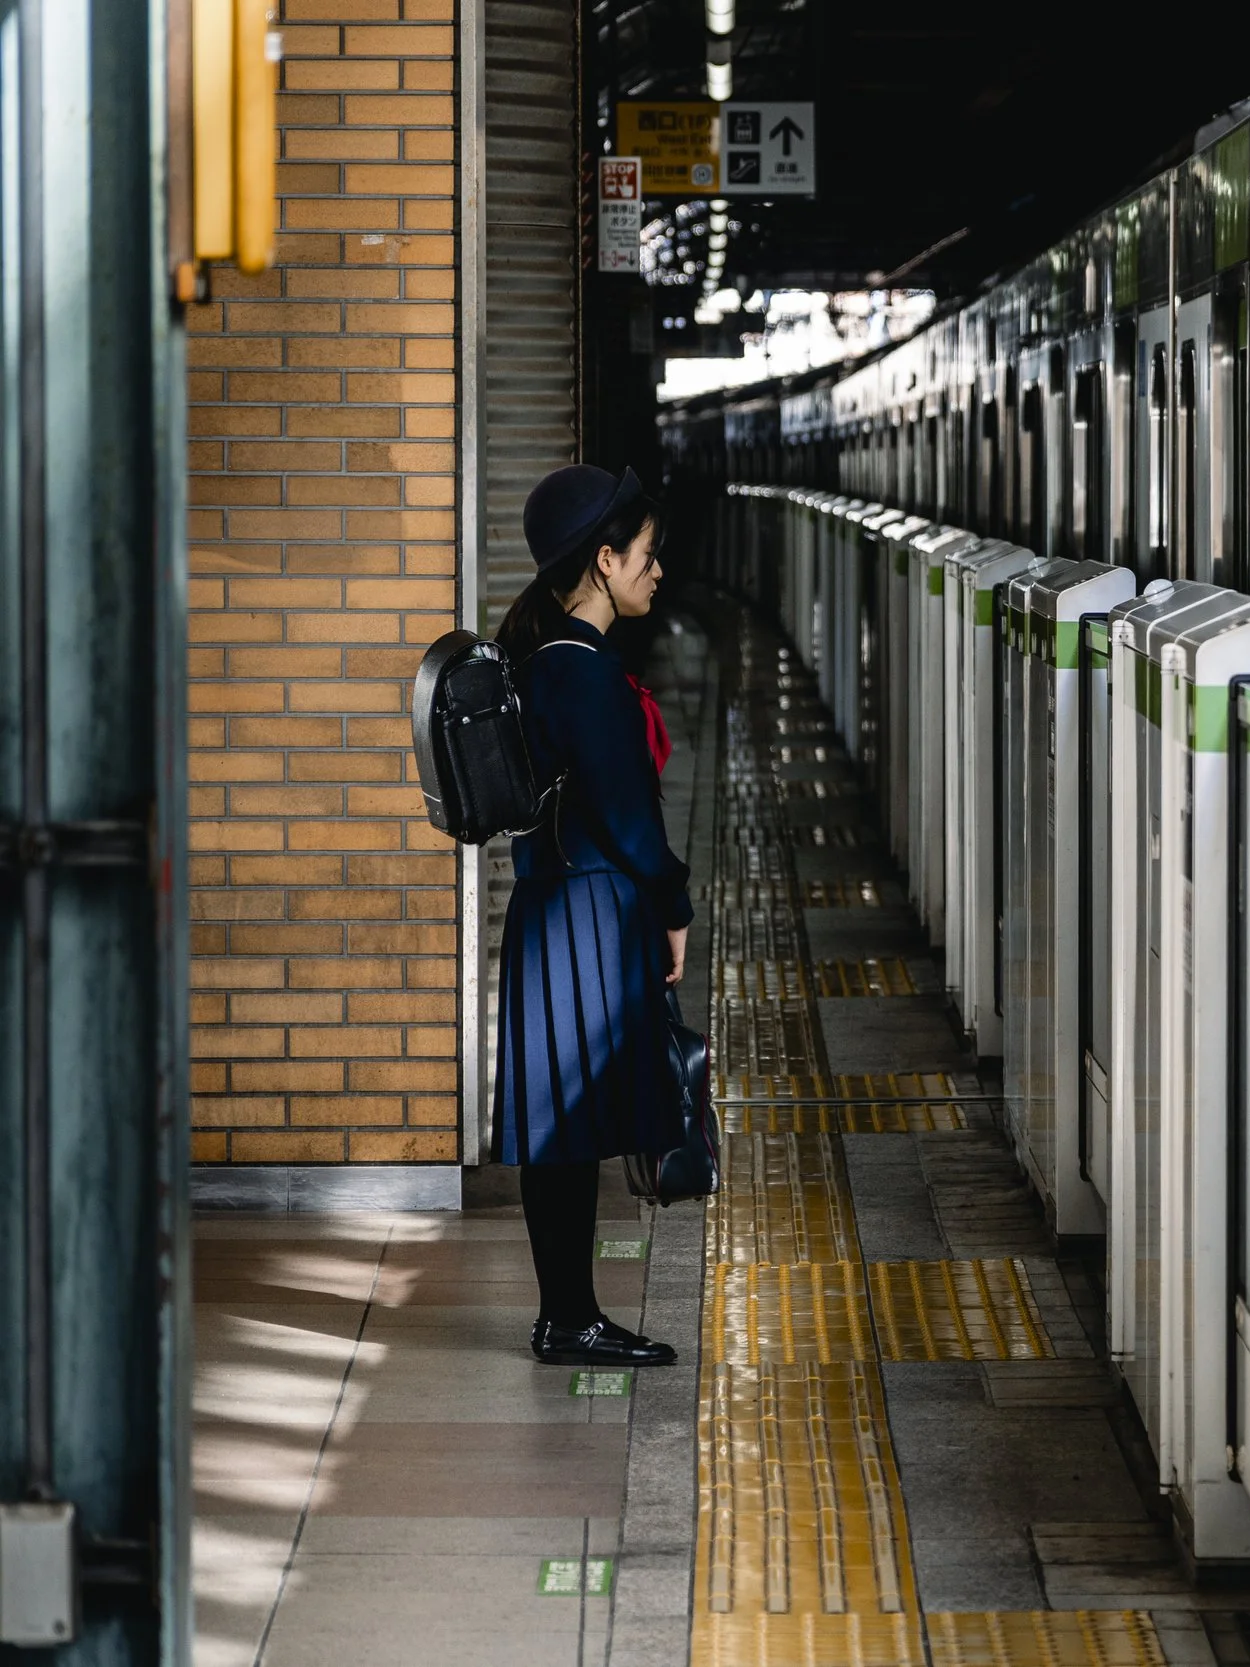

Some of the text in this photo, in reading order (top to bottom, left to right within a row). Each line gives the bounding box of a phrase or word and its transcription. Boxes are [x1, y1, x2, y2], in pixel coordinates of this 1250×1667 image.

[602, 164, 635, 174] STOP
[611, 217, 636, 226] ボタン
